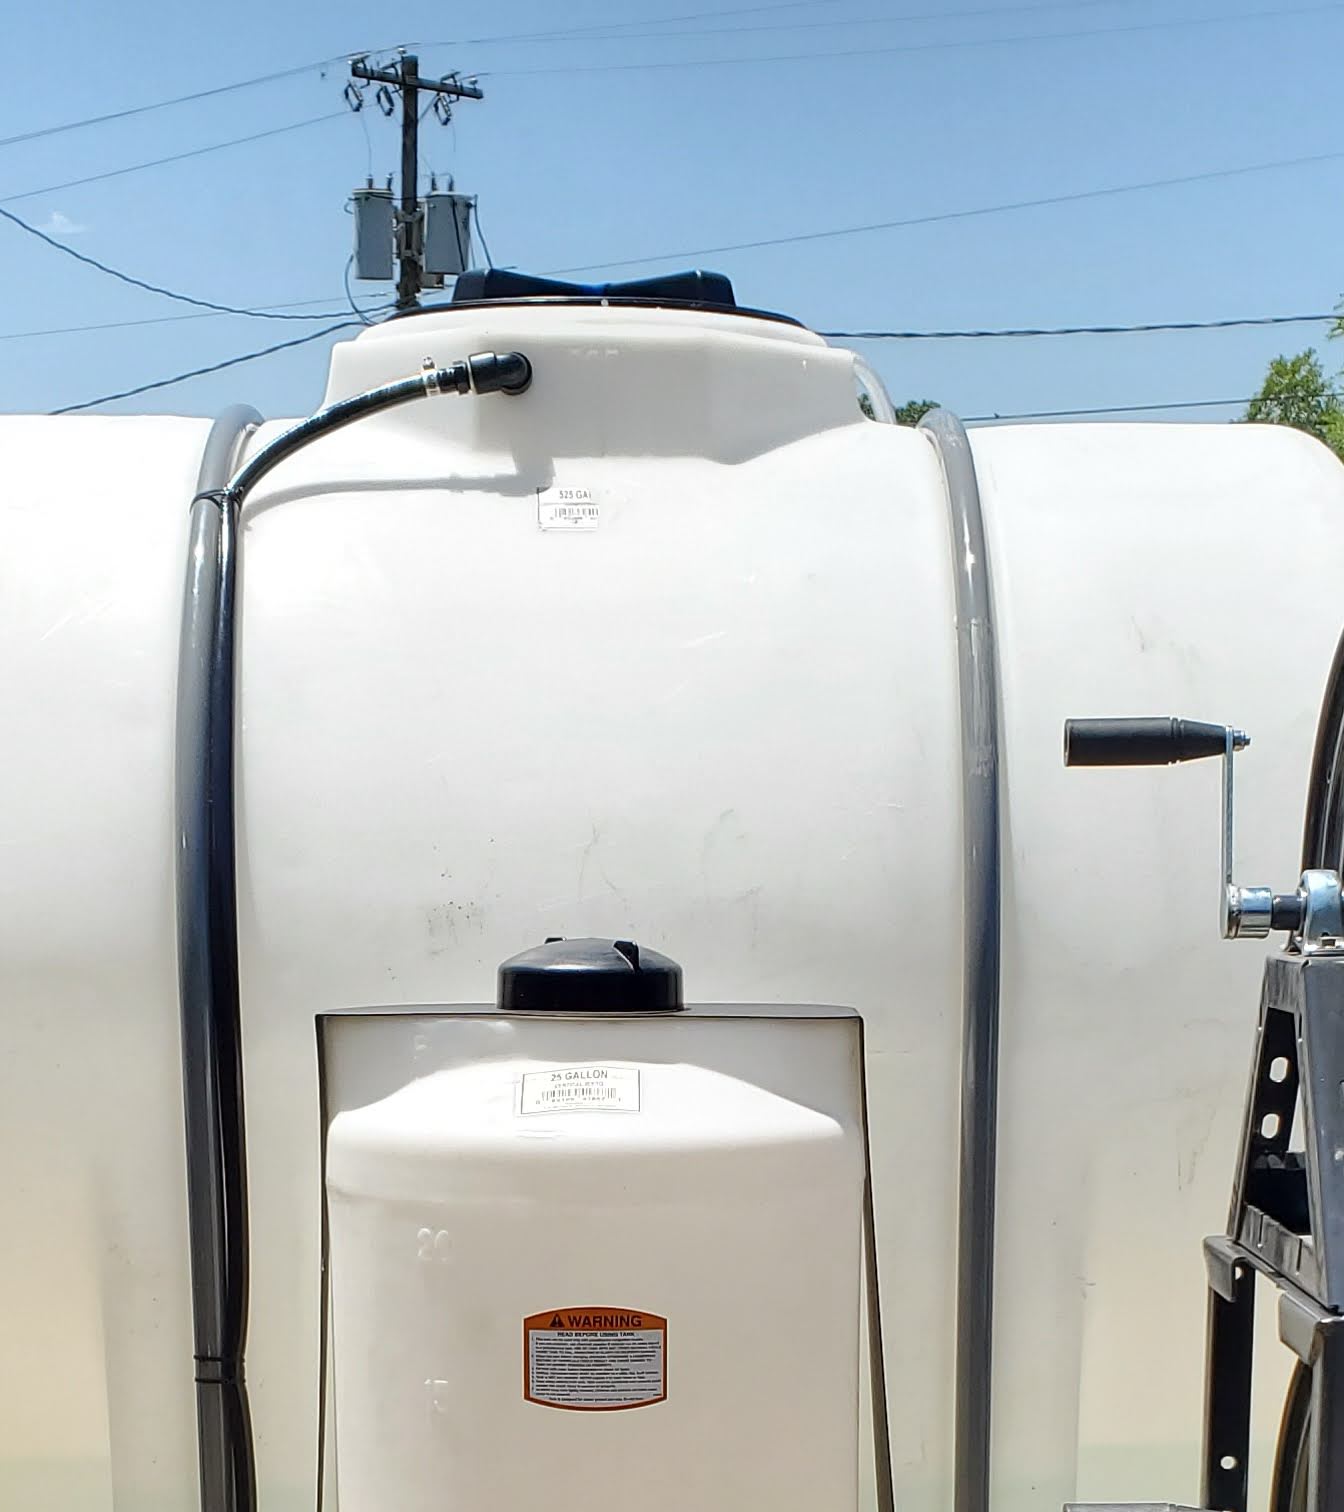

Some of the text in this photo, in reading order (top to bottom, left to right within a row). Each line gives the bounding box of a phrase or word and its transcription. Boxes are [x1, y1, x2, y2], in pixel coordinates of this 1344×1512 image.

[559, 490, 574, 499] 525
[550, 1069, 608, 1082] 25 GALLON
[567, 1315, 642, 1328] WARNING
